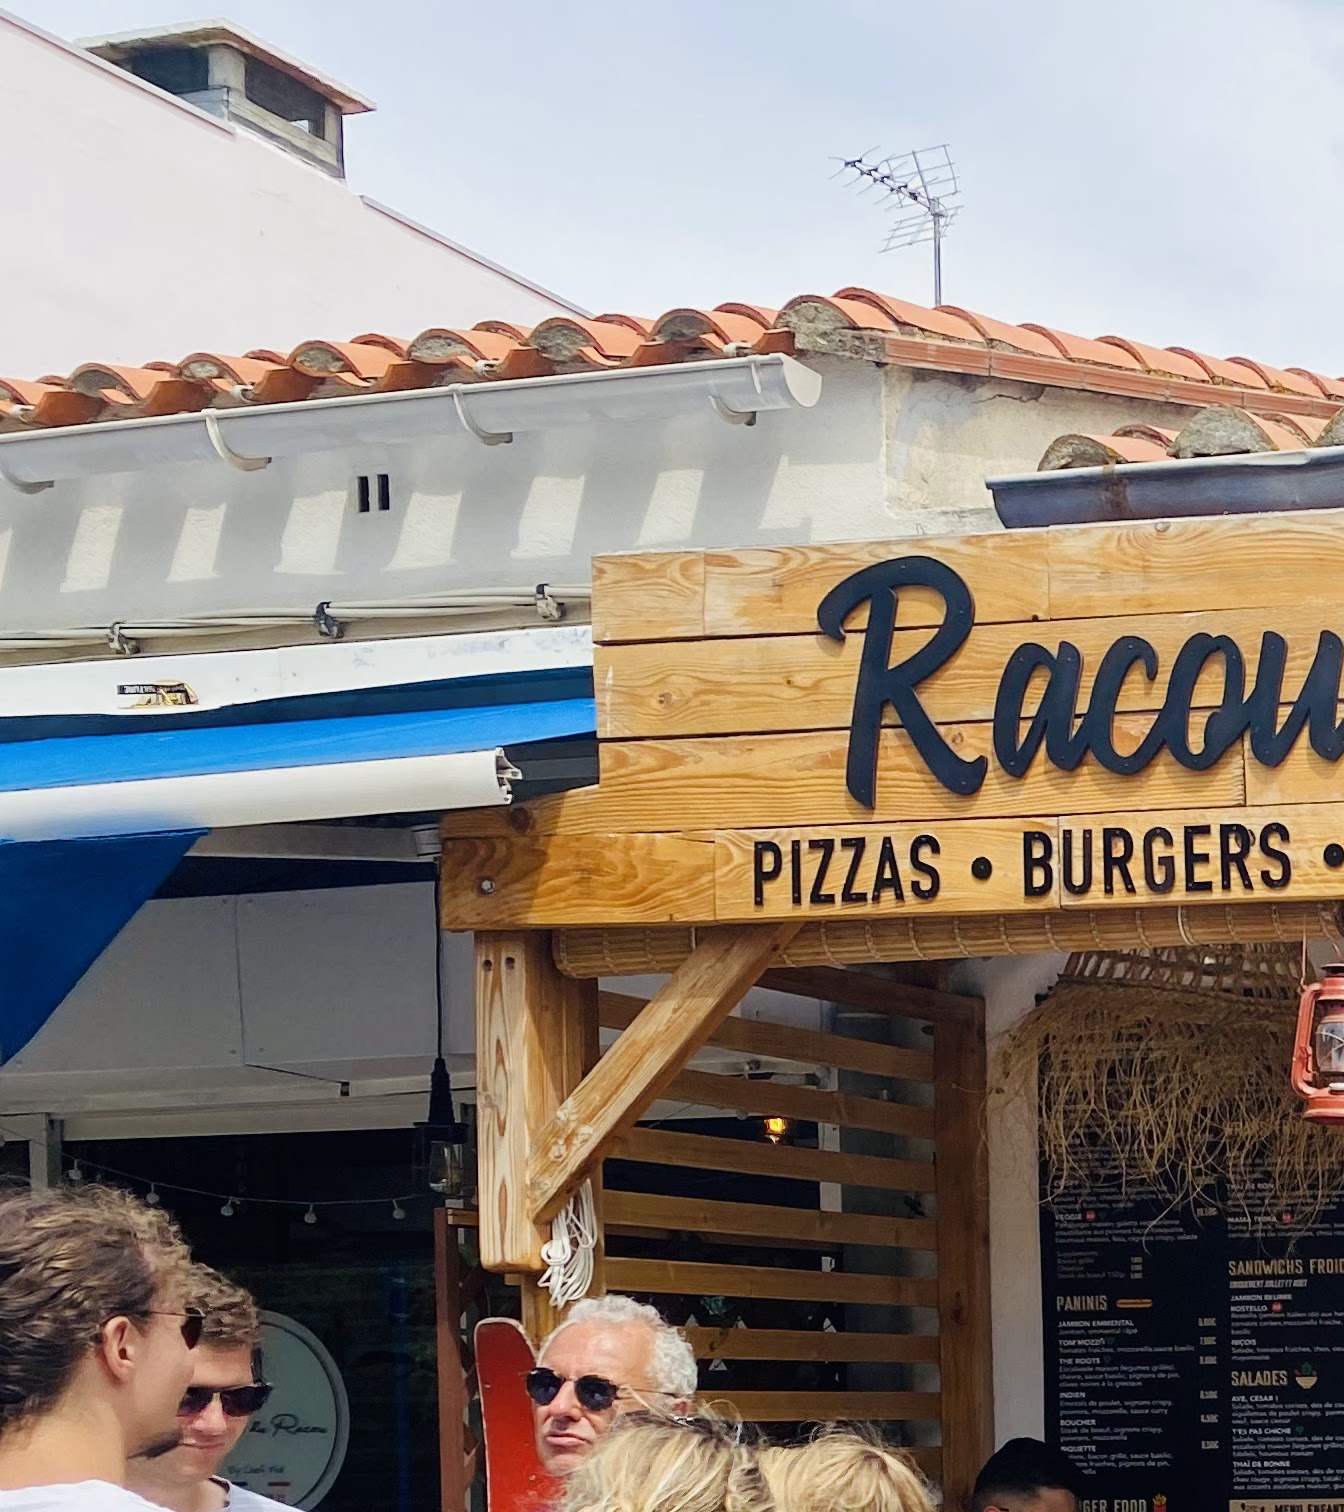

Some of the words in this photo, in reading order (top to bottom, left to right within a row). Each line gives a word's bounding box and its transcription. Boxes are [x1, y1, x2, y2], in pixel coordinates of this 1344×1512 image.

[753, 833, 941, 906] PIZZAS
[1022, 821, 1291, 898] BURGERS
[1228, 1259, 1303, 1276] SANDWICHS
[1057, 1295, 1108, 1312] PANINIS
[1231, 1371, 1288, 1387] SALADES
